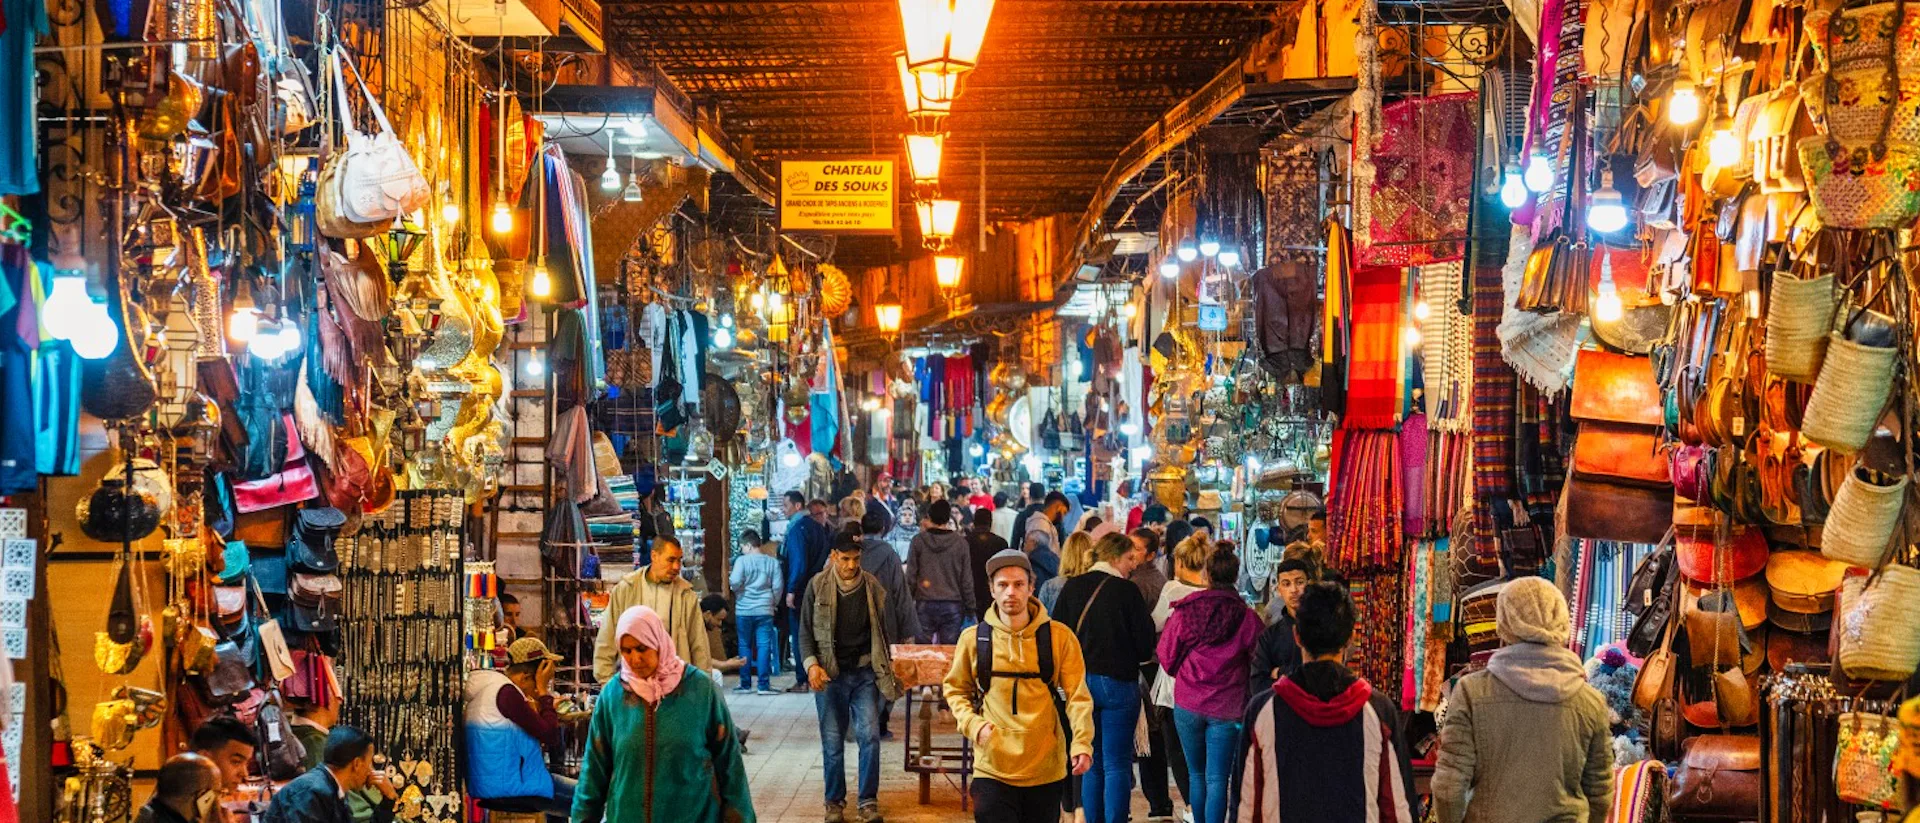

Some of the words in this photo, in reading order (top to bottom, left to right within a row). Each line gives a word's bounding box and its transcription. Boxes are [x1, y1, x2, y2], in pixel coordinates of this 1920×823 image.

[822, 165, 883, 175] CHATEAU
[814, 181, 838, 191] DES
[842, 181, 888, 191] SOUKS
